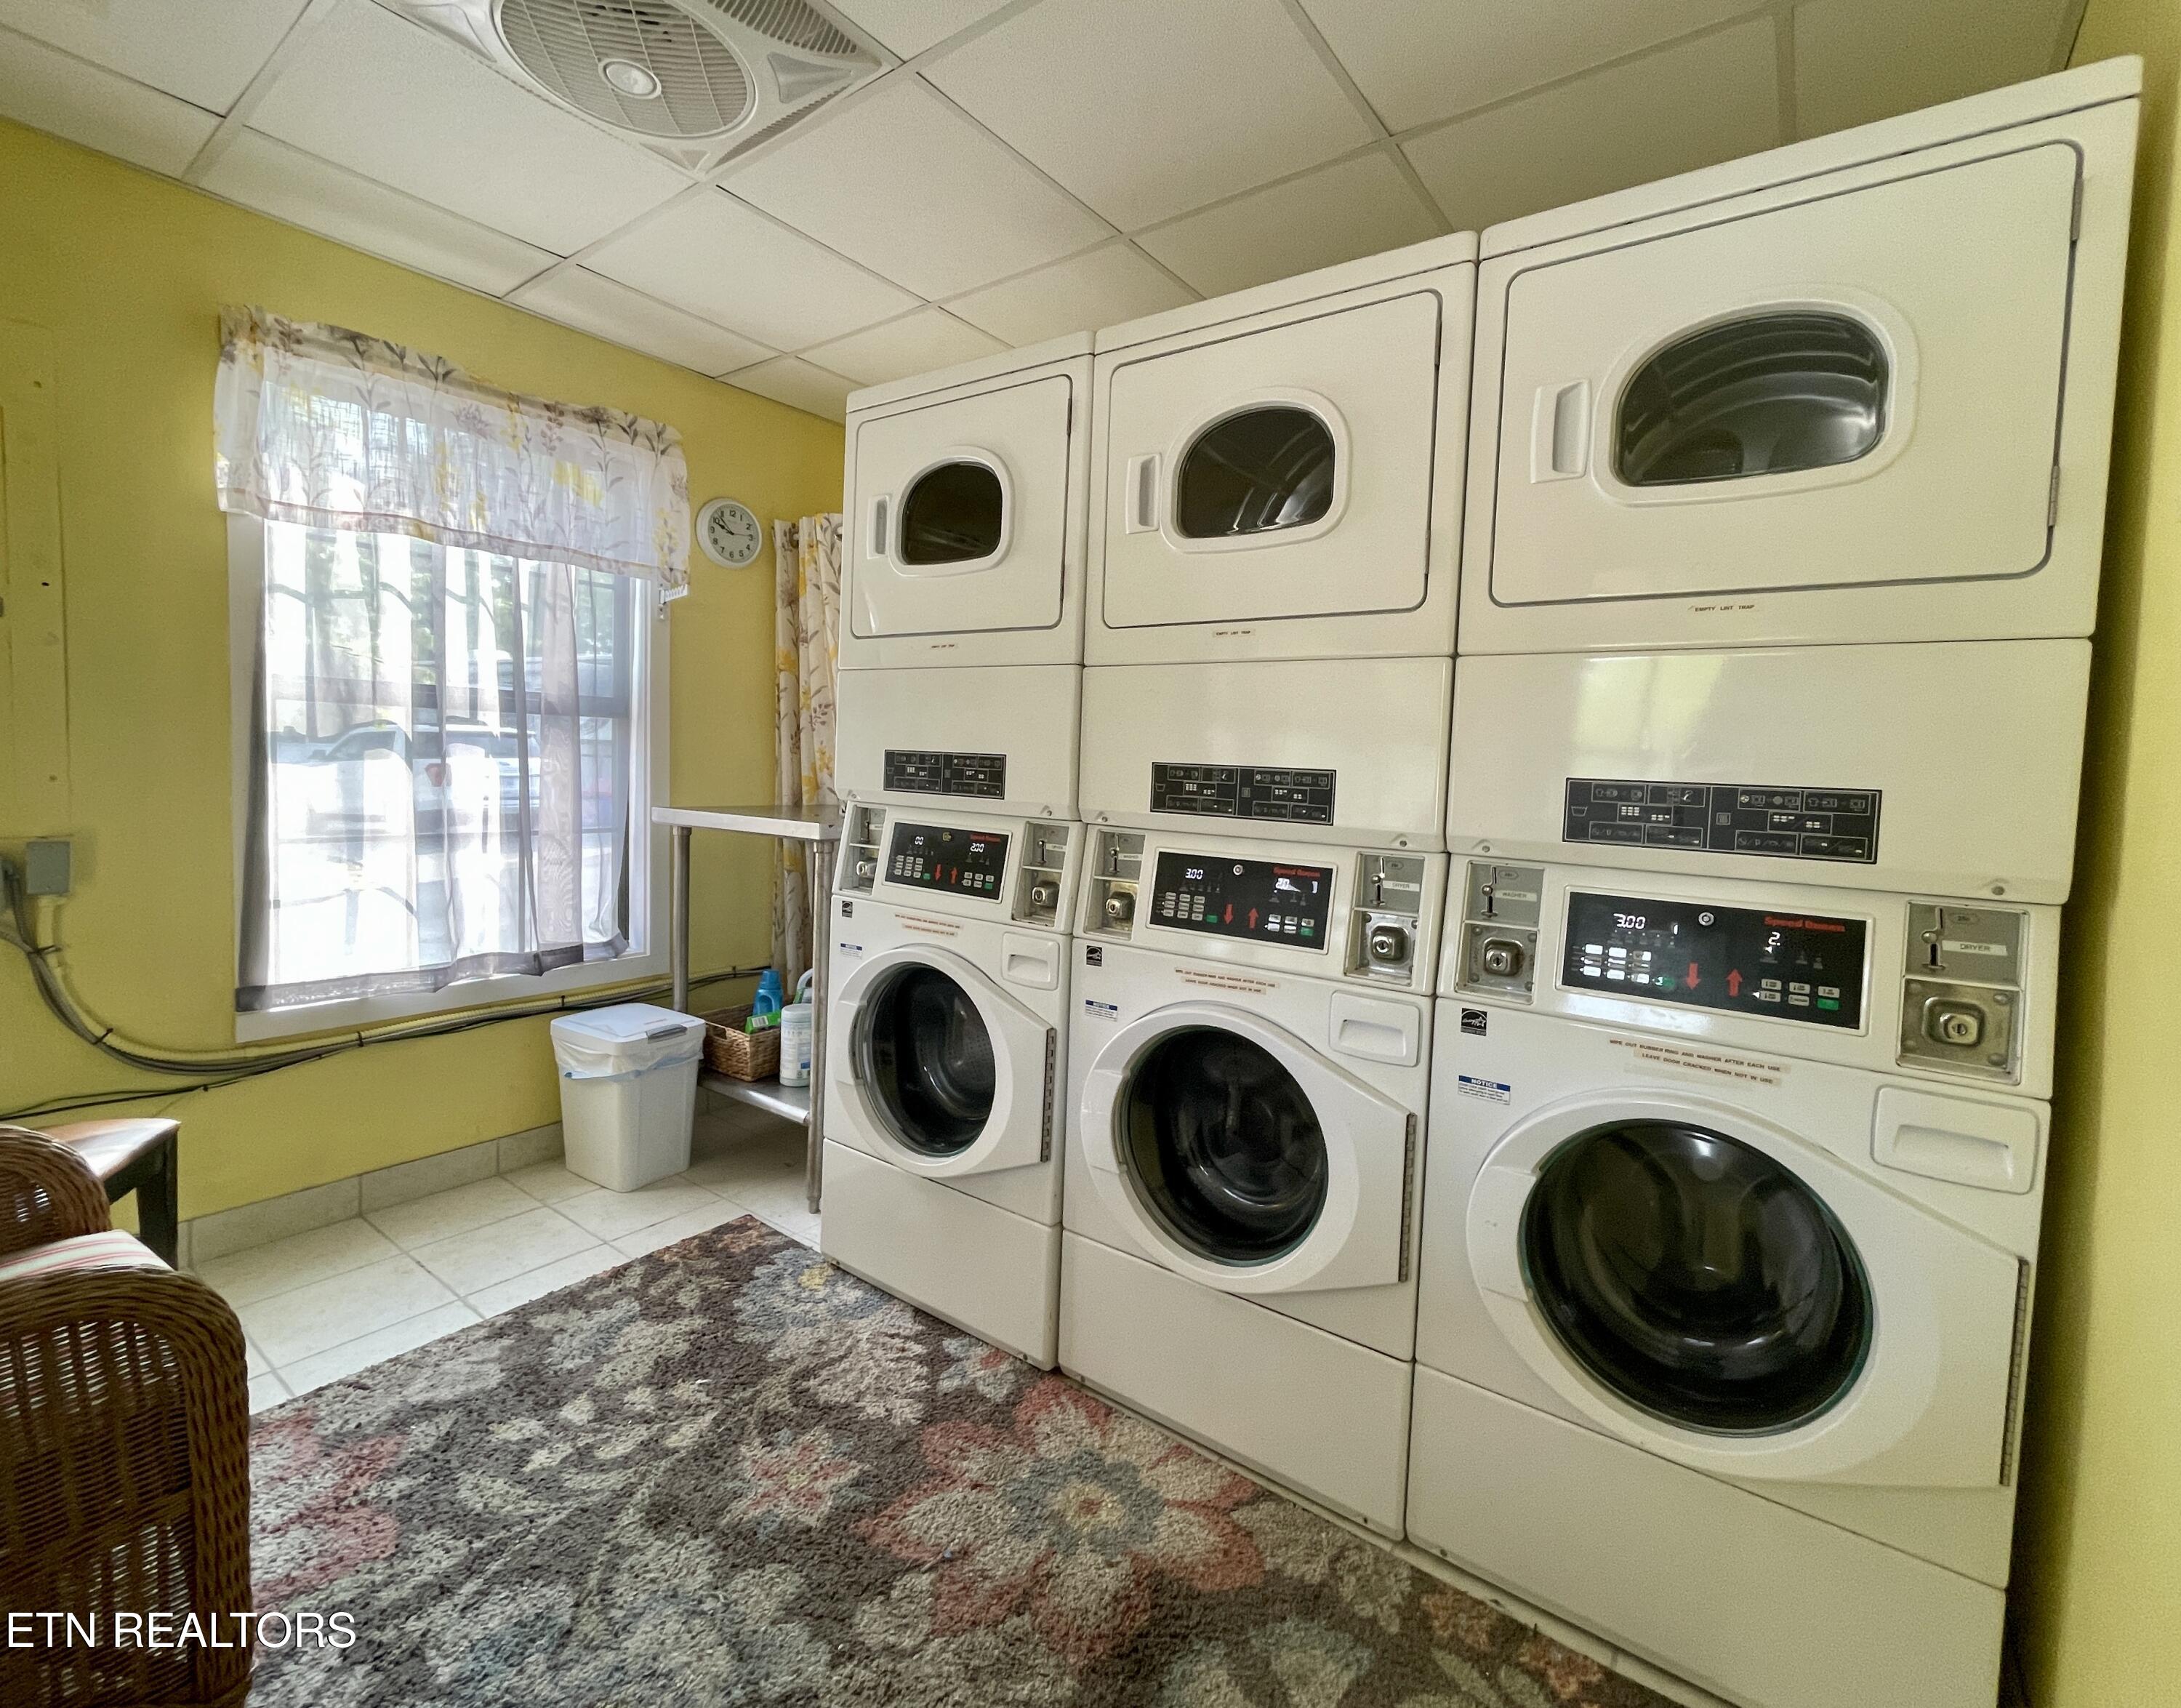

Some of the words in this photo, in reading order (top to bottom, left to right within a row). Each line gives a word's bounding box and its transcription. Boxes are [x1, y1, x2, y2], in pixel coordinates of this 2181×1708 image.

[1959, 943, 1991, 952] DRYER
[1642, 1053, 1660, 1062] LEAVE
[1471, 1078, 1498, 1088] NOTICE
